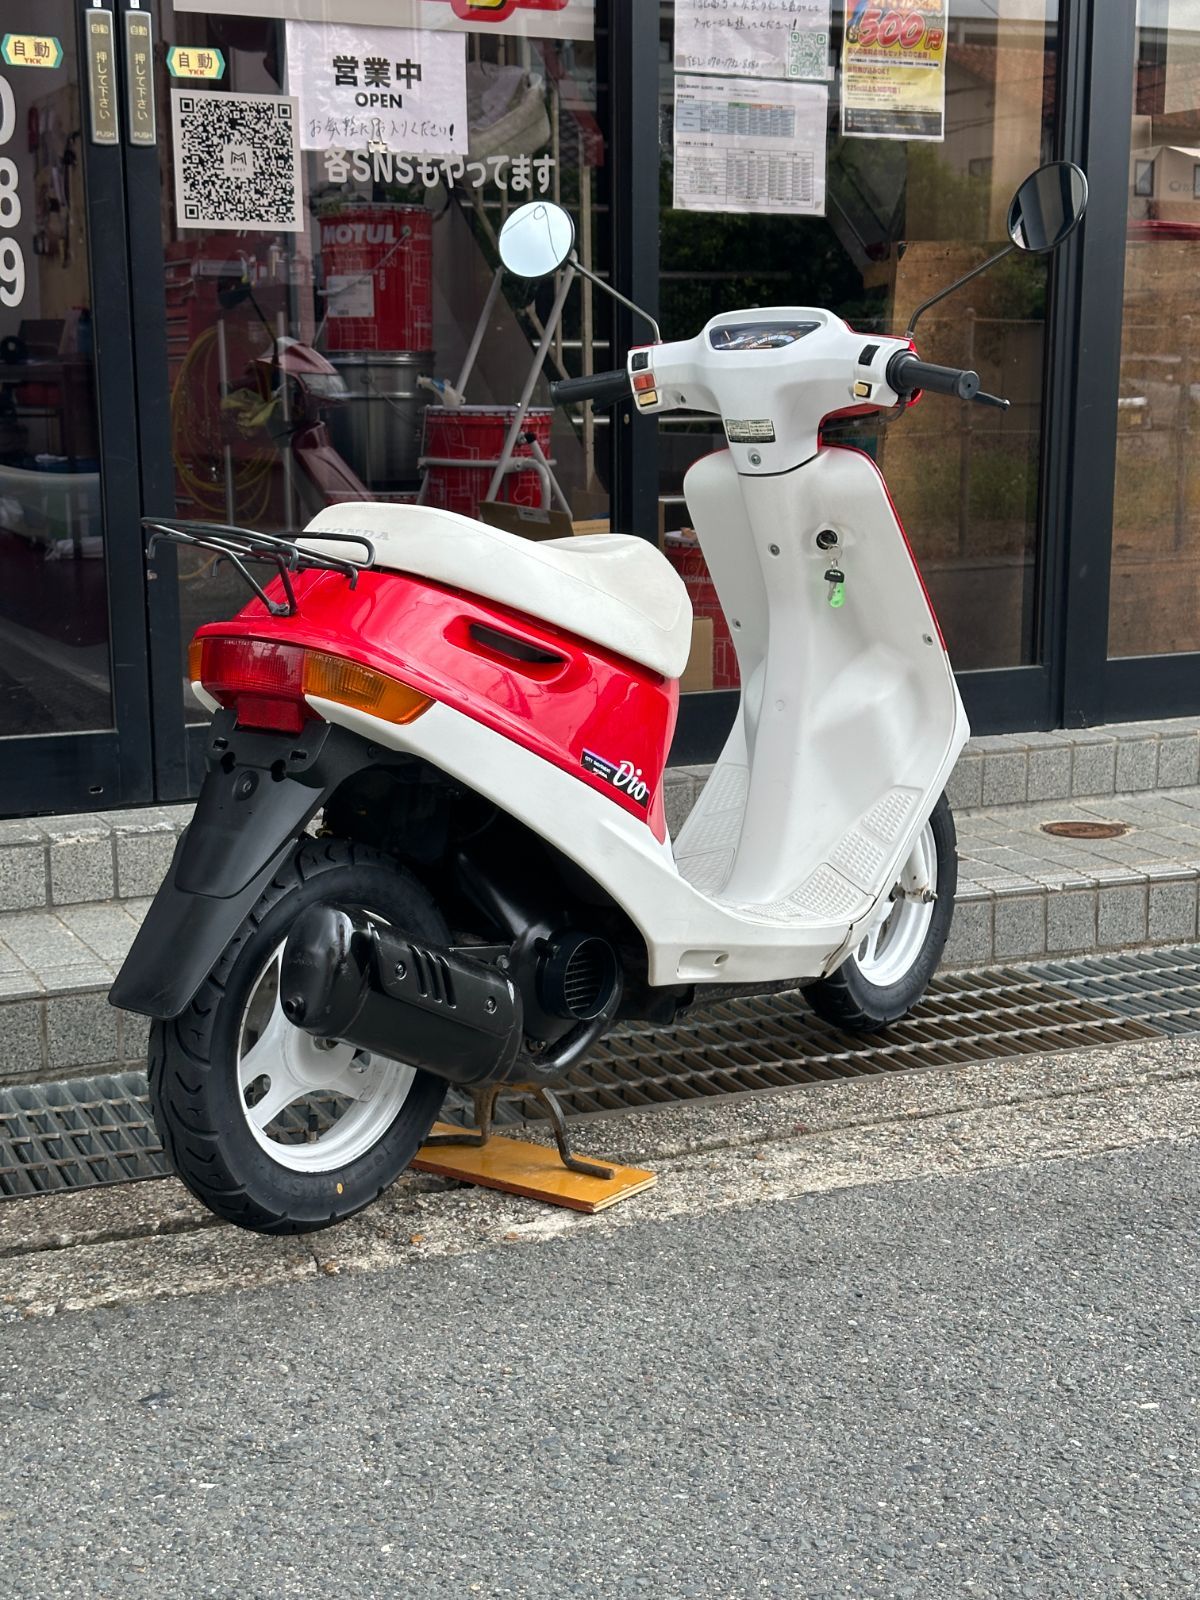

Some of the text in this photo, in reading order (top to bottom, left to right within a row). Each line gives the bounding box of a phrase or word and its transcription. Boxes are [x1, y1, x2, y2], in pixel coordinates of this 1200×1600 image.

[14, 40, 50, 58] 自動
[179, 52, 213, 69] 自動
[96, 51, 110, 119] 押して下さい
[134, 52, 149, 120] 押して下さい
[332, 55, 422, 90] 営業中
[355, 92, 403, 109] OPEN
[324, 145, 556, 194] 各SNSもやってます
[322, 223, 397, 245] MOTUL
[612, 760, 647, 800] Dio
